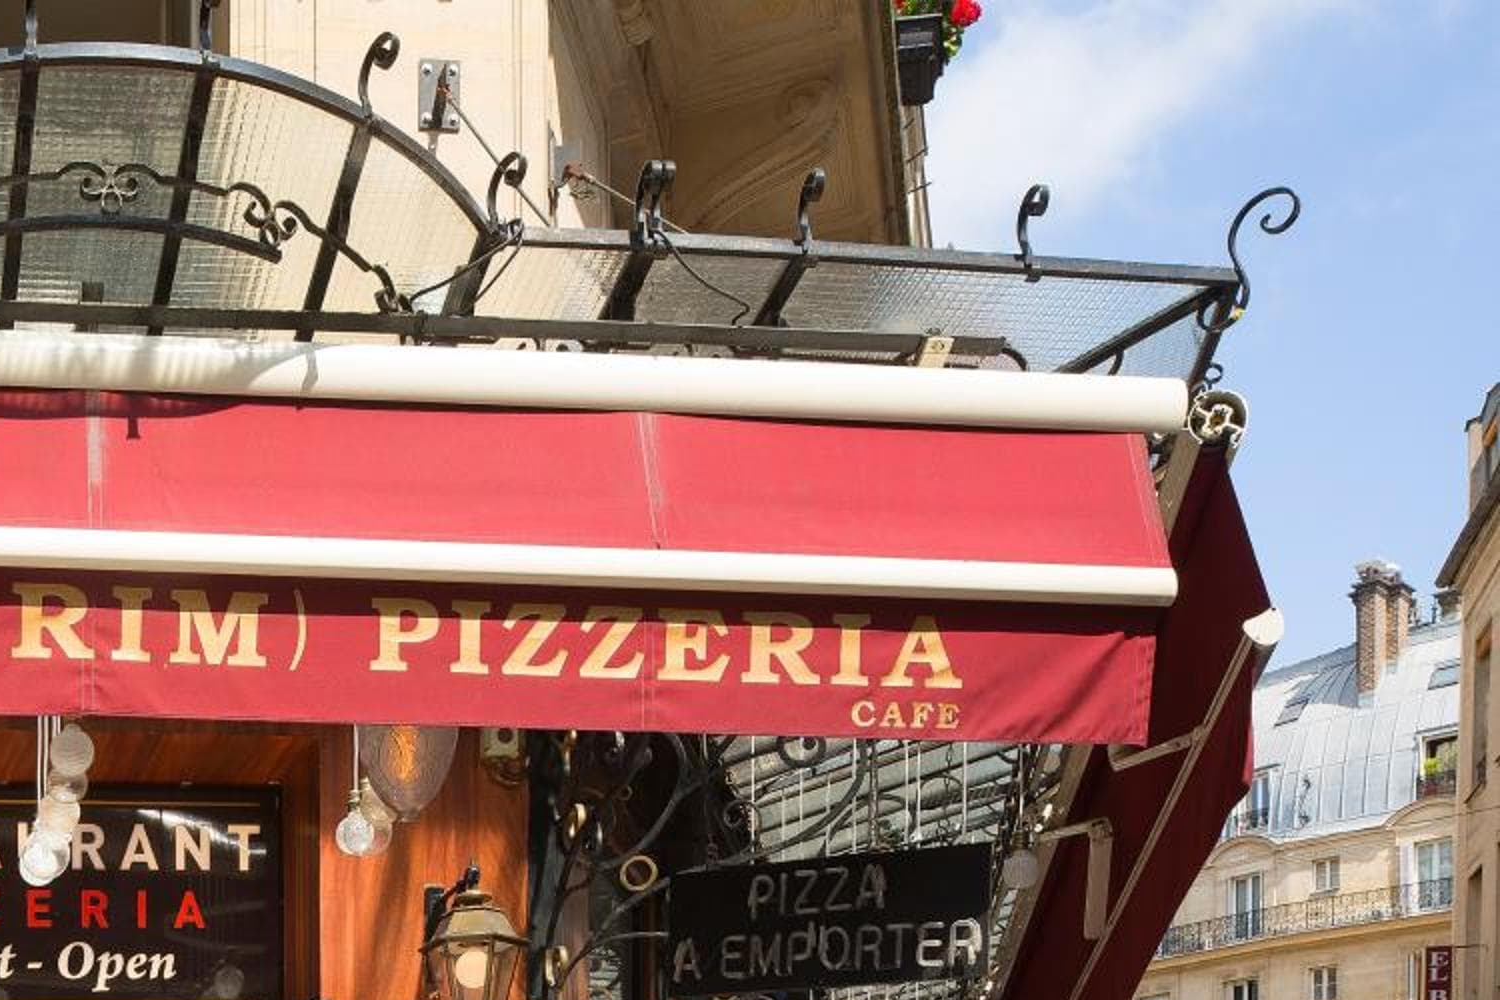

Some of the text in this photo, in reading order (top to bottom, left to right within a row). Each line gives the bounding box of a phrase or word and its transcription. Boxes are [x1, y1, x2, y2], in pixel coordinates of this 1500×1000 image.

[370, 598, 963, 690] PIZZERIA
[851, 700, 961, 731] CAFE
[748, 863, 888, 920] PIZZA
[57, 941, 177, 993] Open
[720, 917, 983, 979] EMPORTER
[1427, 951, 1449, 982] EL
